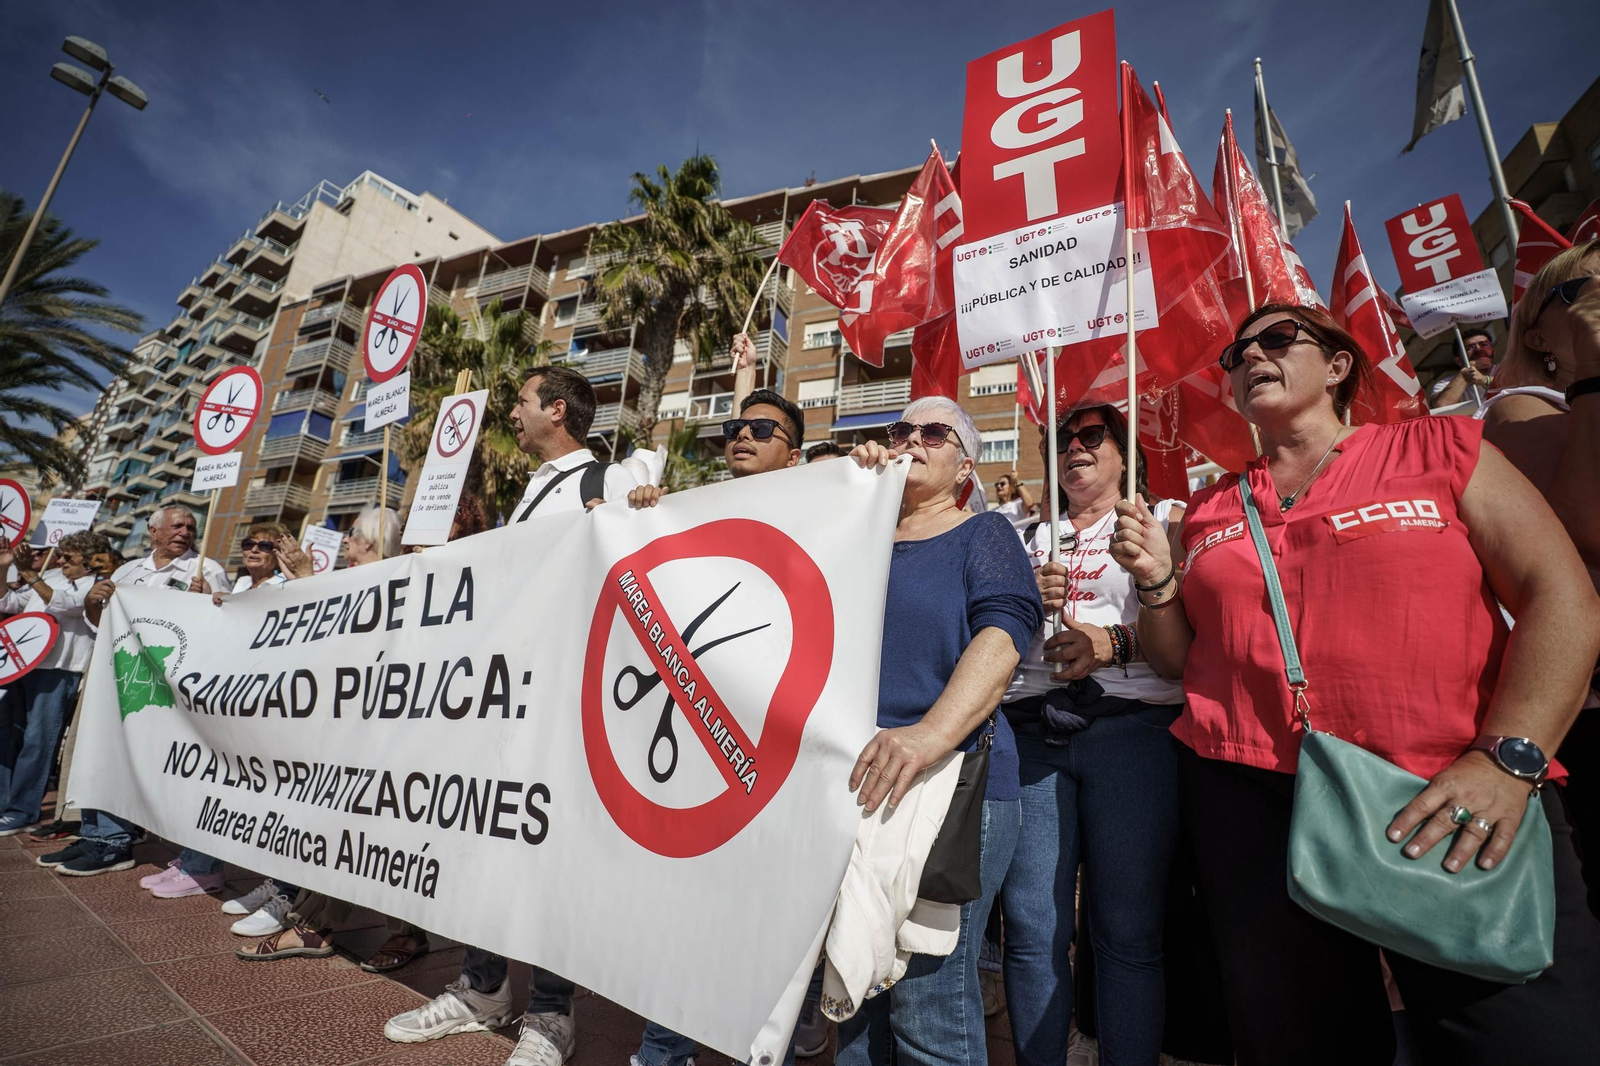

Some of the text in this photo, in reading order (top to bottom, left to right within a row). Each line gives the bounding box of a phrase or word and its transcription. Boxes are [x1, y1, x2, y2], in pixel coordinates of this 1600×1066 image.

[990, 29, 1086, 222] UGT
[1077, 212, 1101, 225] UGT
[1015, 231, 1036, 245] UGT
[1400, 202, 1462, 284] UGT
[957, 249, 977, 262] UGT
[1009, 236, 1078, 269] SANIDAD
[1029, 280, 1038, 291] Y
[1041, 275, 1060, 289] DE
[1420, 296, 1449, 307] MORENO
[1087, 315, 1111, 330] UGT
[1022, 329, 1045, 343] UGT
[965, 346, 986, 359] UGT
[367, 385, 406, 408] MAREA BLANCA
[374, 402, 397, 419] ALMERÍA
[196, 461, 237, 473] MAREA BLANCA
[202, 472, 227, 483] ALMERÍA
[436, 472, 457, 480] sanidad
[1330, 499, 1441, 531] CCOO
[1400, 518, 1446, 528] ALMERÍA
[249, 566, 475, 649] DEFIENDE LA
[177, 650, 533, 720] SANIDAD PÚBLICA:
[618, 570, 759, 795] MAREA BLANCA ALMERÍA
[163, 741, 552, 846] NO A LAS PRIVATIZACIONES
[196, 796, 441, 899] Marea Blanca Almería
